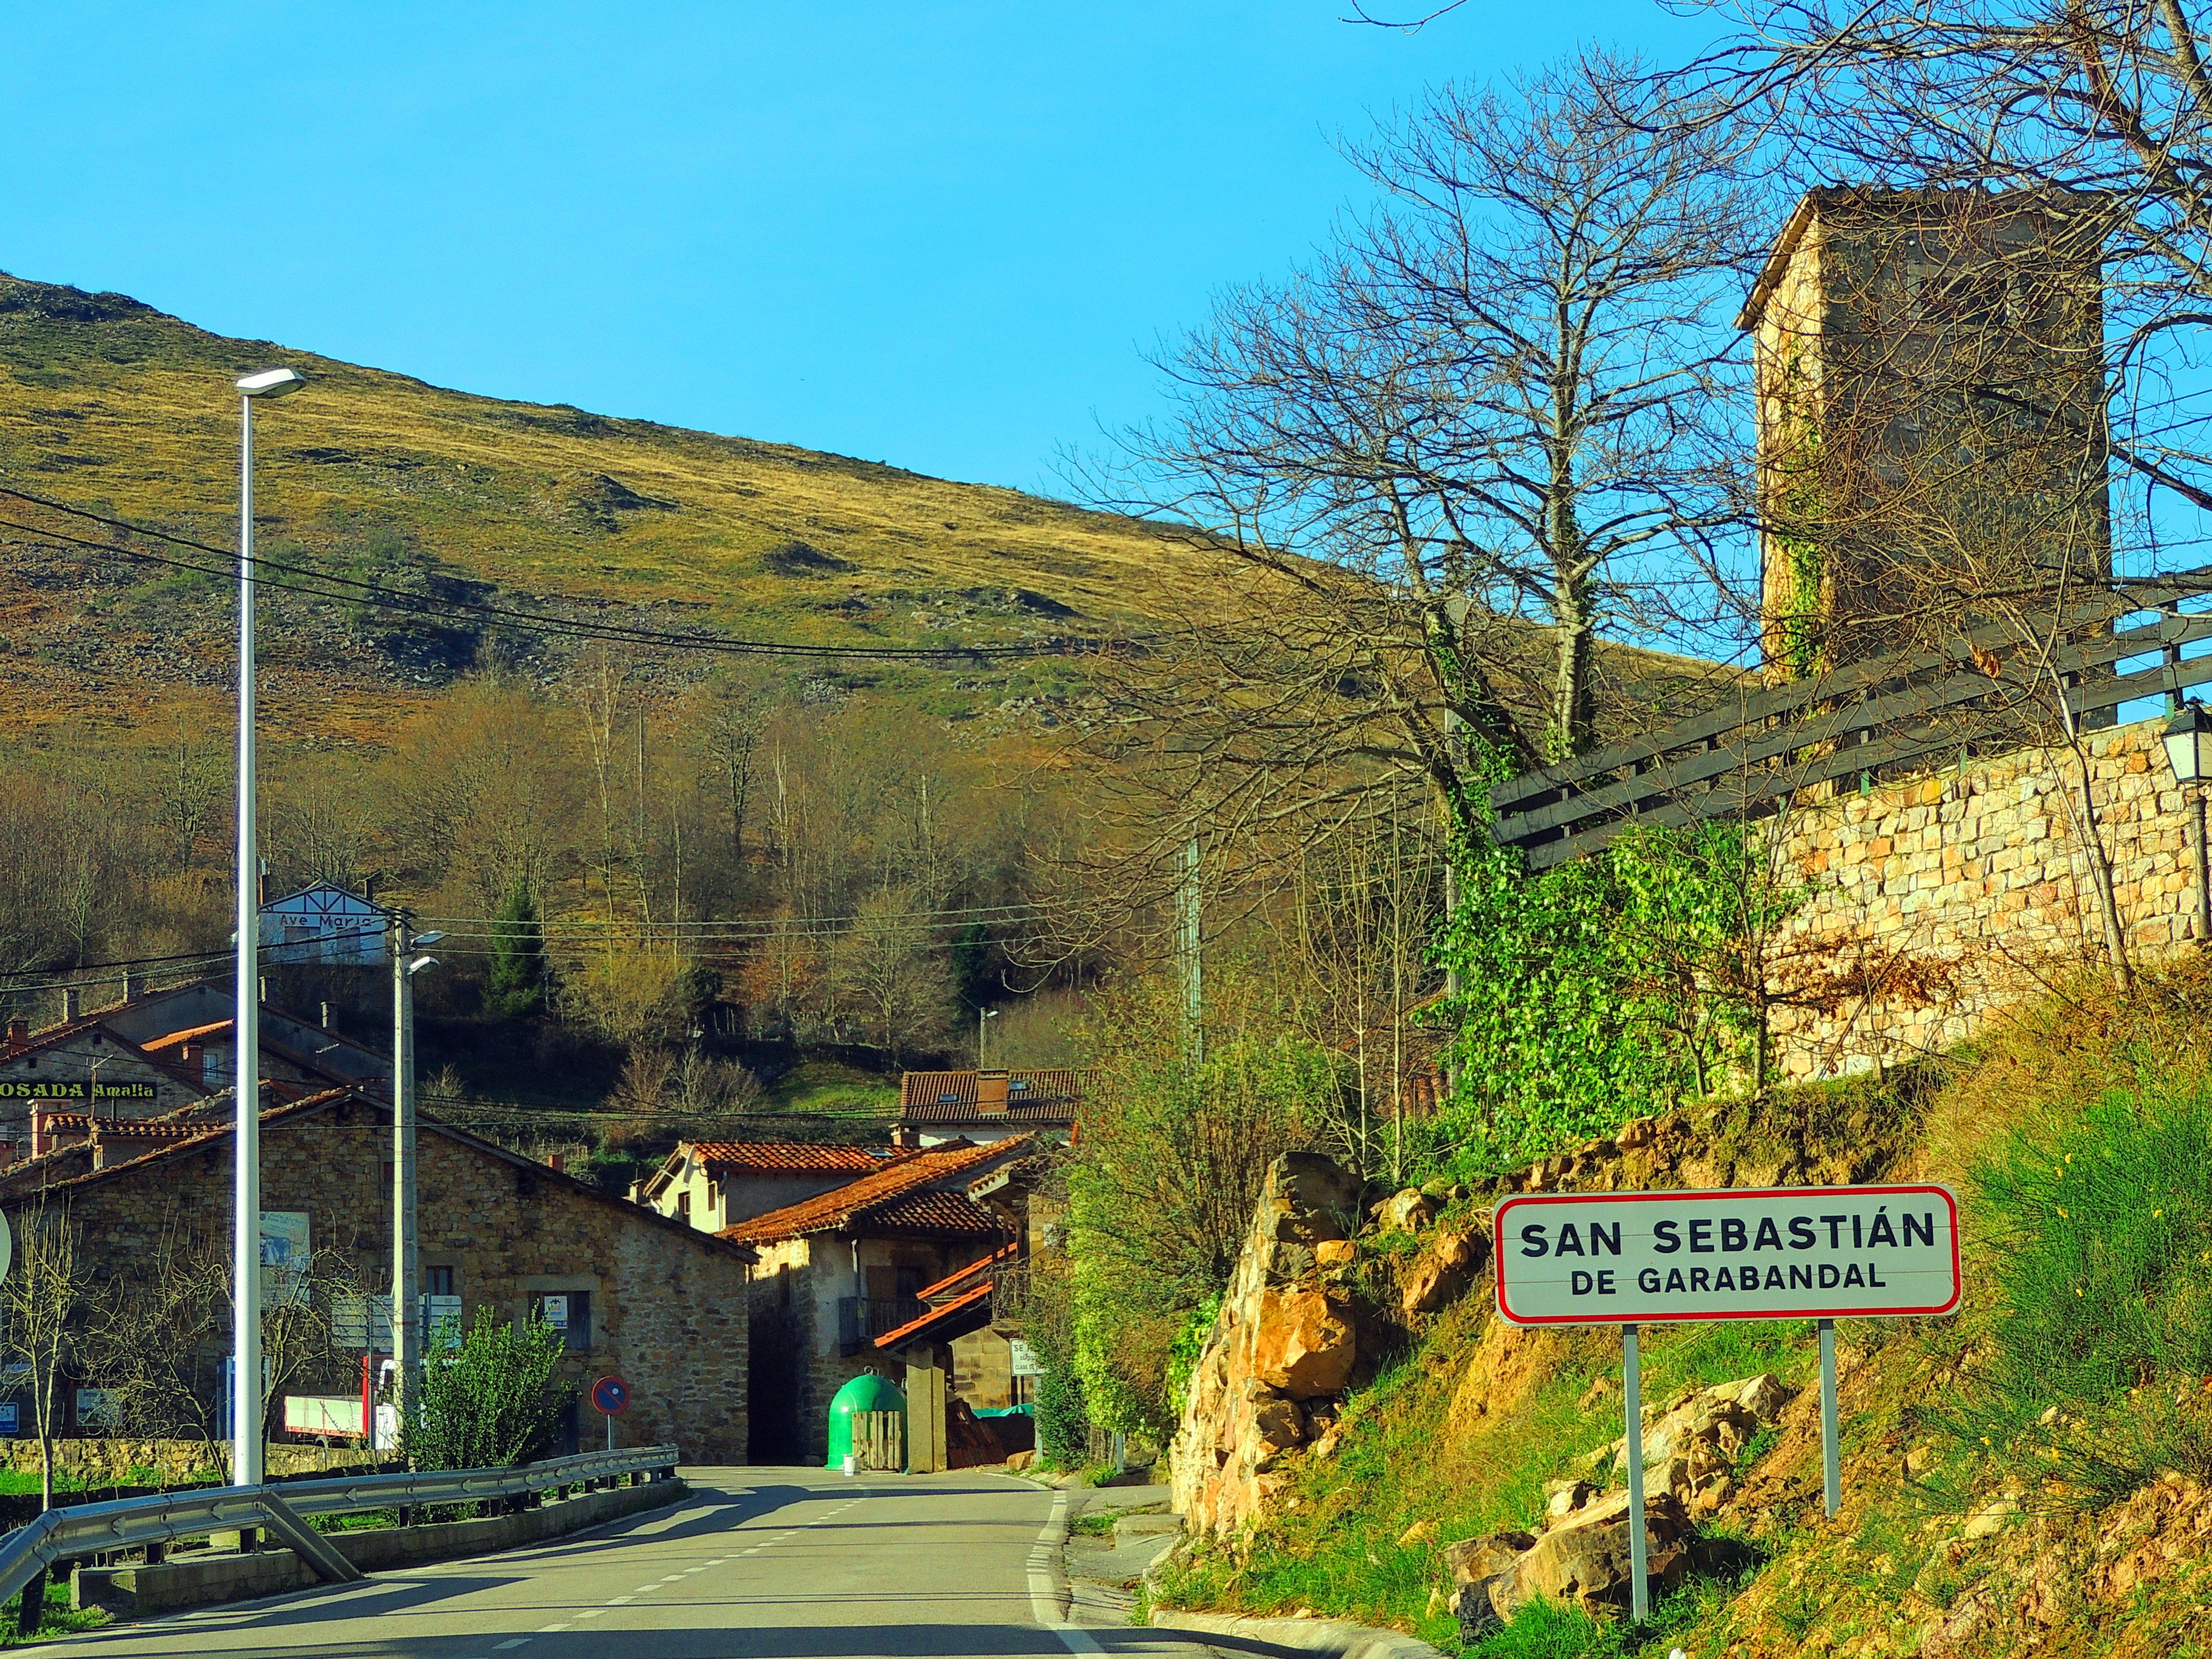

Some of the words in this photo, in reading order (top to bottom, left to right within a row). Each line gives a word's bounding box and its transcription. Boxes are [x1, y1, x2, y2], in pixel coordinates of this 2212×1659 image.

[280, 914, 308, 925] Ave
[95, 1083, 153, 1097] Amalia
[1521, 1222, 1622, 1257] SAN
[1653, 1206, 1934, 1253] SEBASTIÁN
[1571, 1270, 1616, 1295] DE
[1638, 1262, 1886, 1293] GARABANDAL
